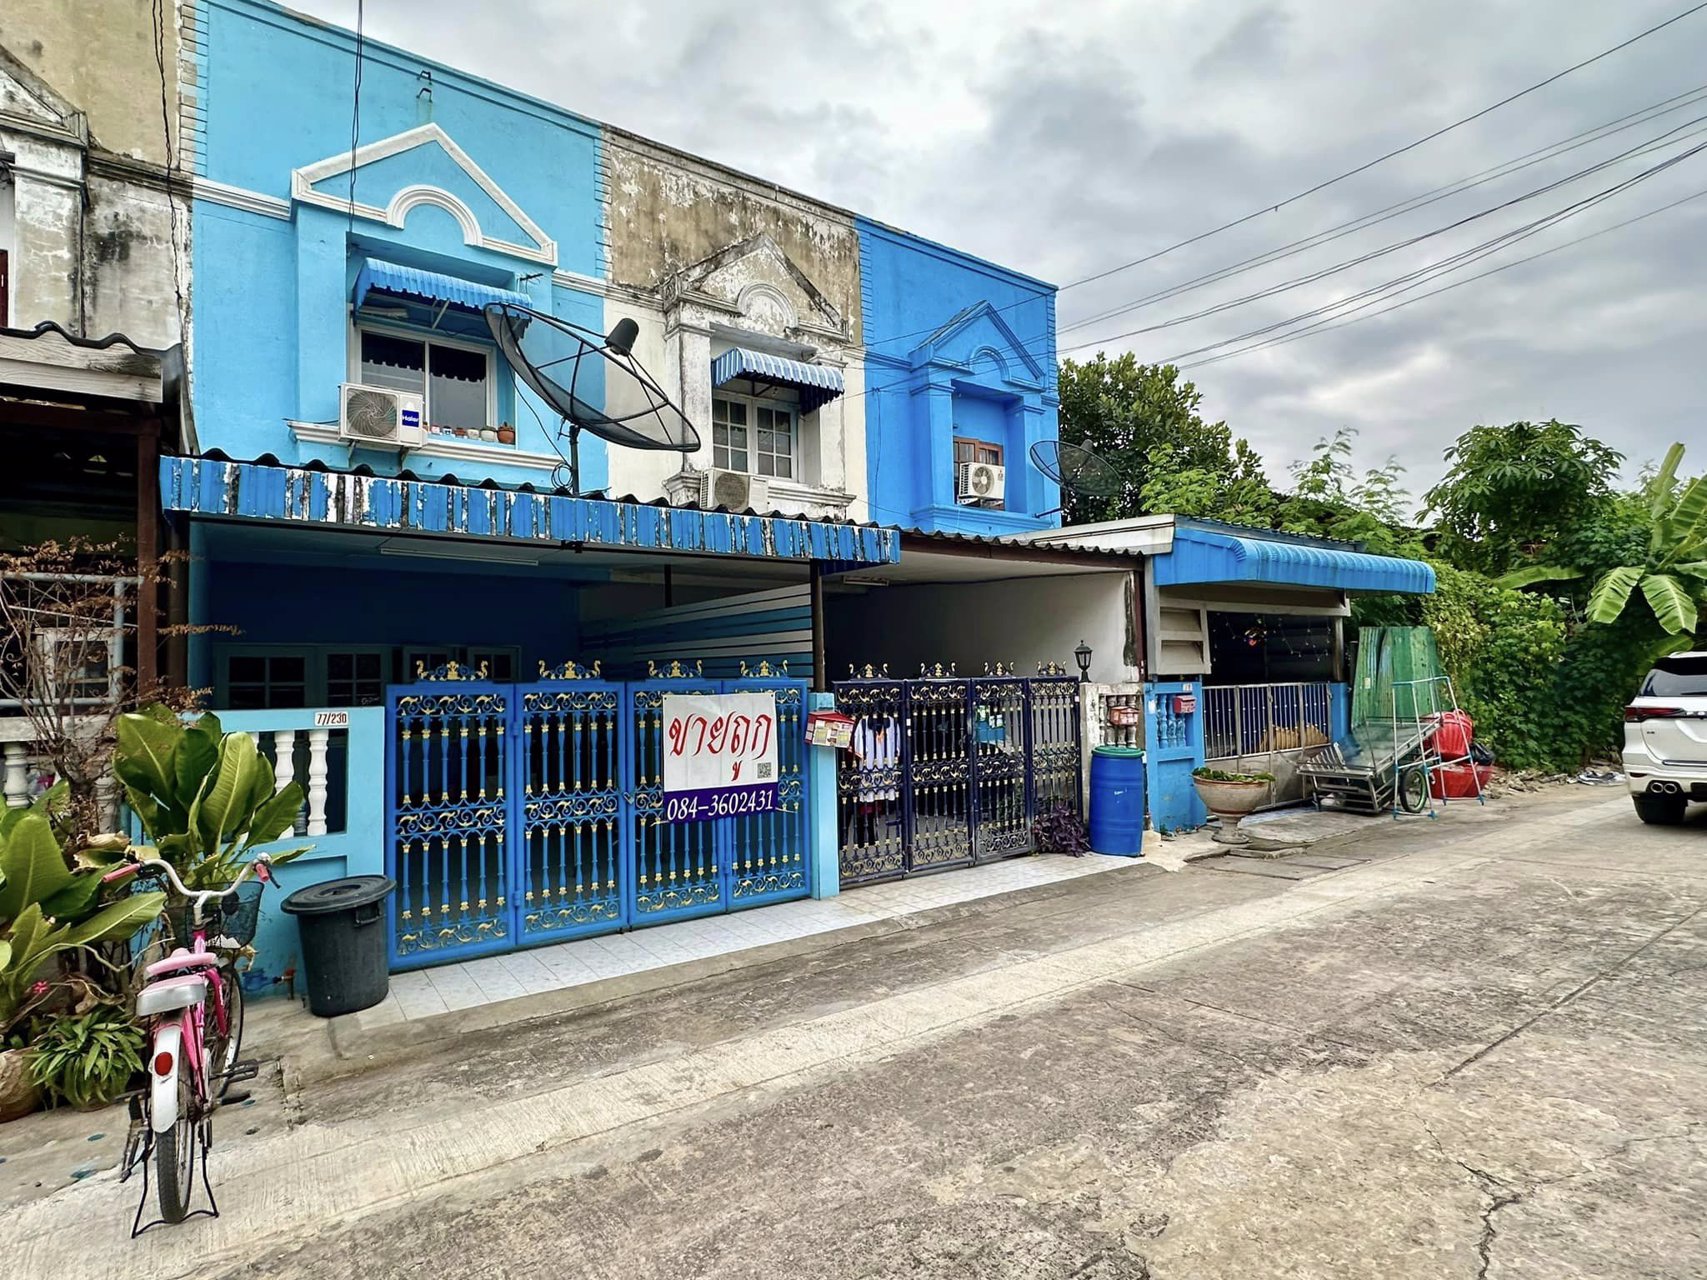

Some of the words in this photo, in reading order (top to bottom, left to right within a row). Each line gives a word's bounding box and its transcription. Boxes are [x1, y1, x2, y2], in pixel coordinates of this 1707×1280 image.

[317, 712, 347, 726] 77/230
[668, 711, 772, 781] ขายถูก
[667, 790, 774, 821] 084-3602431
